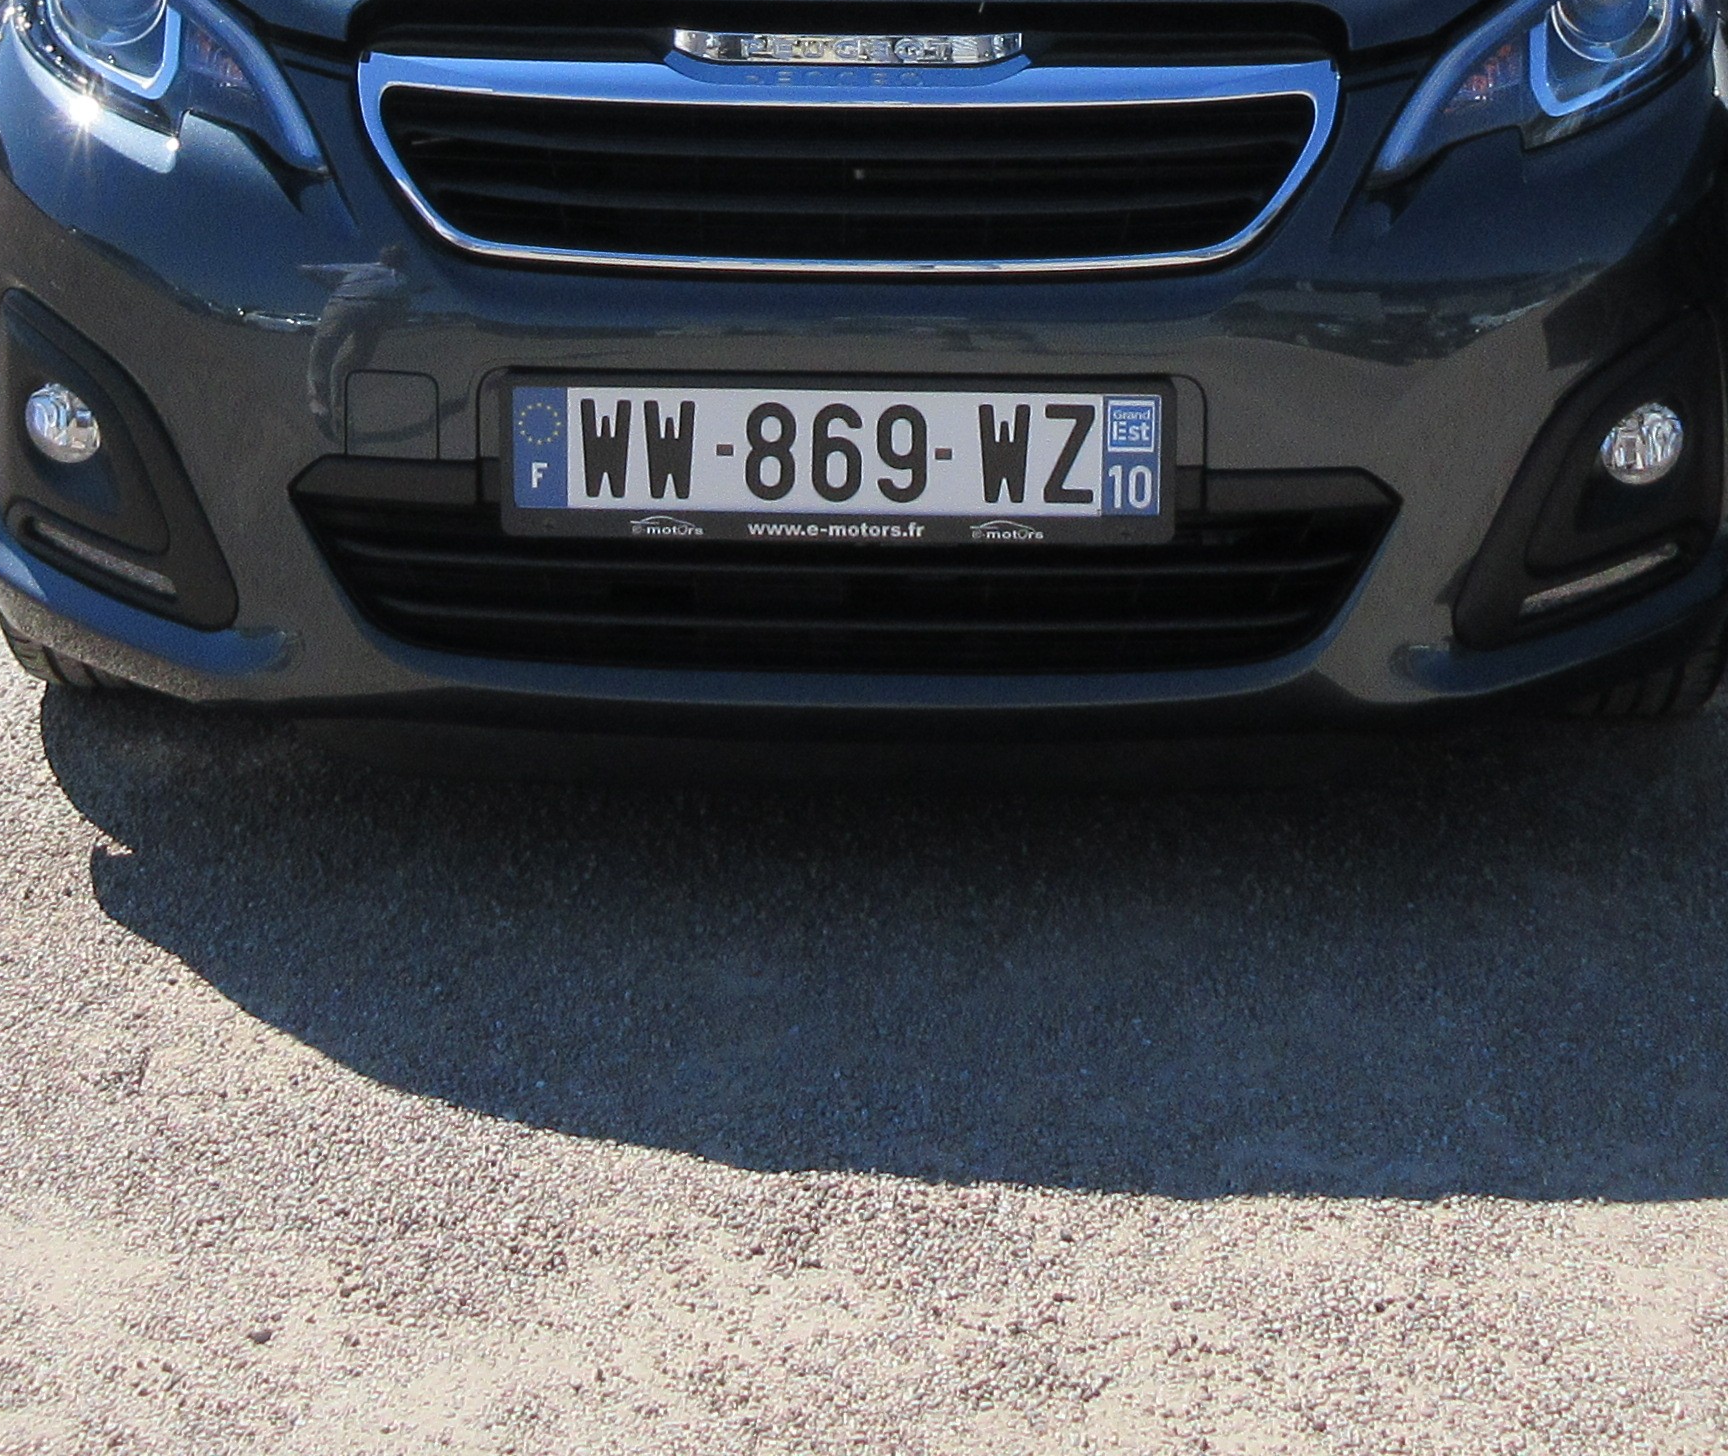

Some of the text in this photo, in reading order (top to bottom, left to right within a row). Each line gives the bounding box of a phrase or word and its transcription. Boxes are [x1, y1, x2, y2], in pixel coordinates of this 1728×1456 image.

[1112, 408, 1151, 420] Grand
[1112, 420, 1150, 441] Est
[531, 462, 547, 489] F
[1108, 464, 1153, 509] 10
[747, 518, 925, 539] www.e-motors.fr
